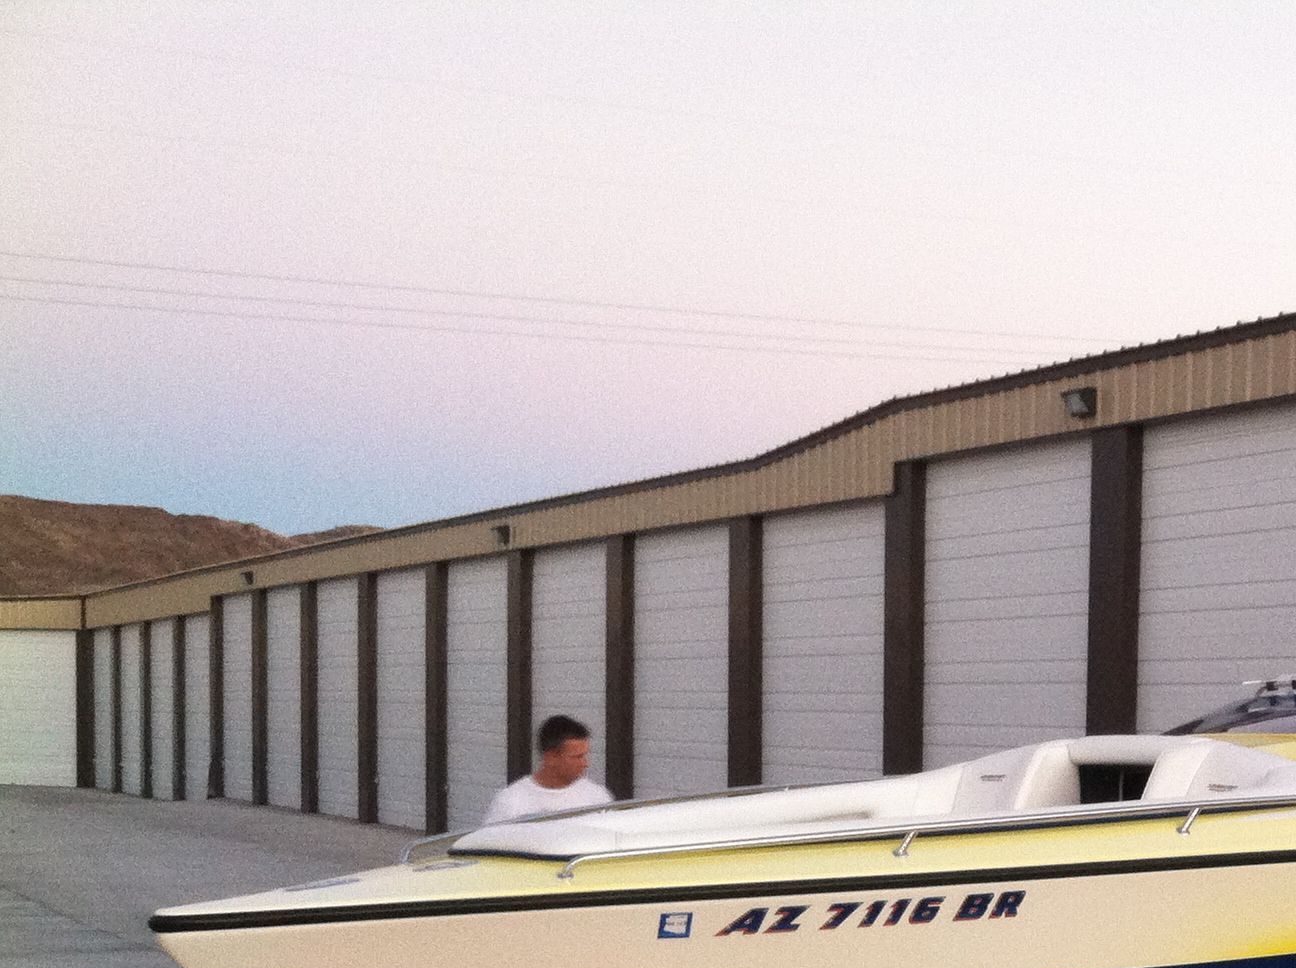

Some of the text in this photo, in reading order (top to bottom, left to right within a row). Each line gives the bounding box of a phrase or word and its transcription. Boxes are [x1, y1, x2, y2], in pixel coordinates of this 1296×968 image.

[714, 890, 1027, 936] AZ 7116 BR
